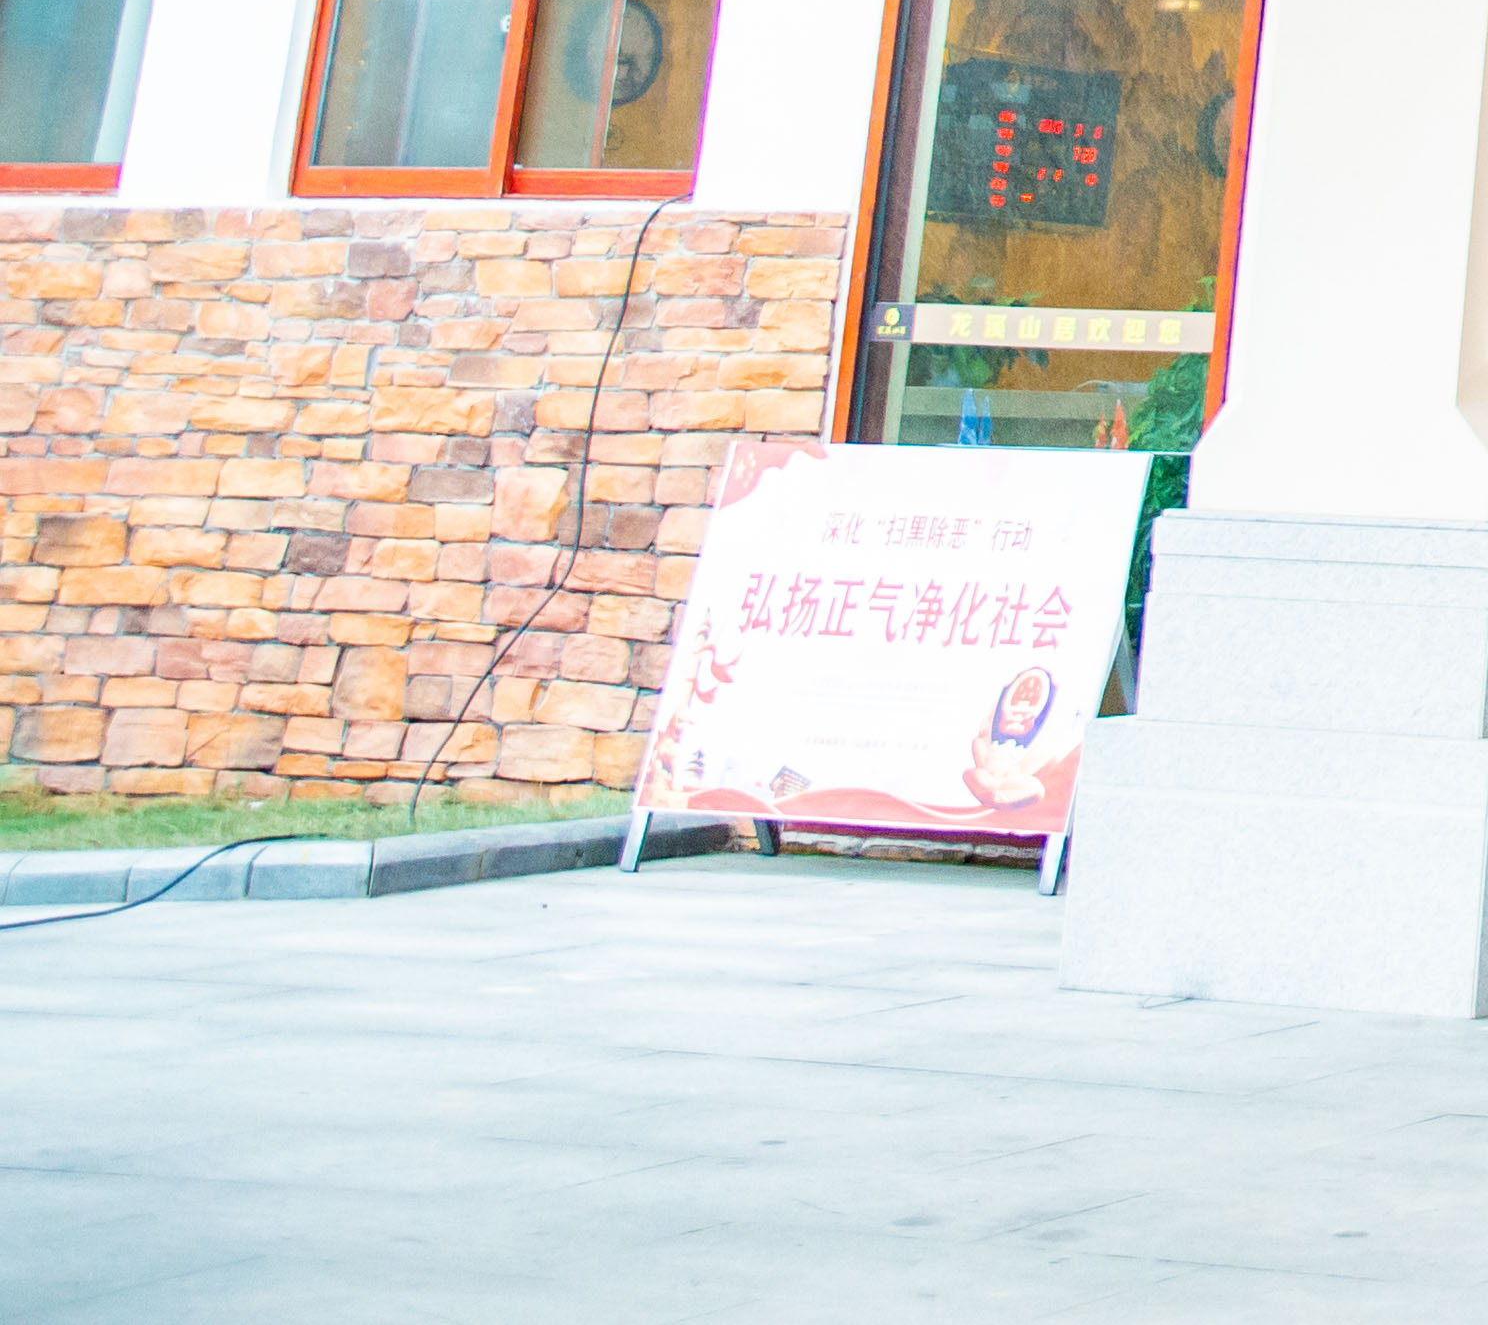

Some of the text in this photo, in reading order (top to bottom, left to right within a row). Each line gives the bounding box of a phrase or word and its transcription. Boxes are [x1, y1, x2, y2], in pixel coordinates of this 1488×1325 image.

[949, 313, 1182, 343] 龙溪山居欢迎您
[740, 573, 1073, 650] 弘扬正气净化社会
